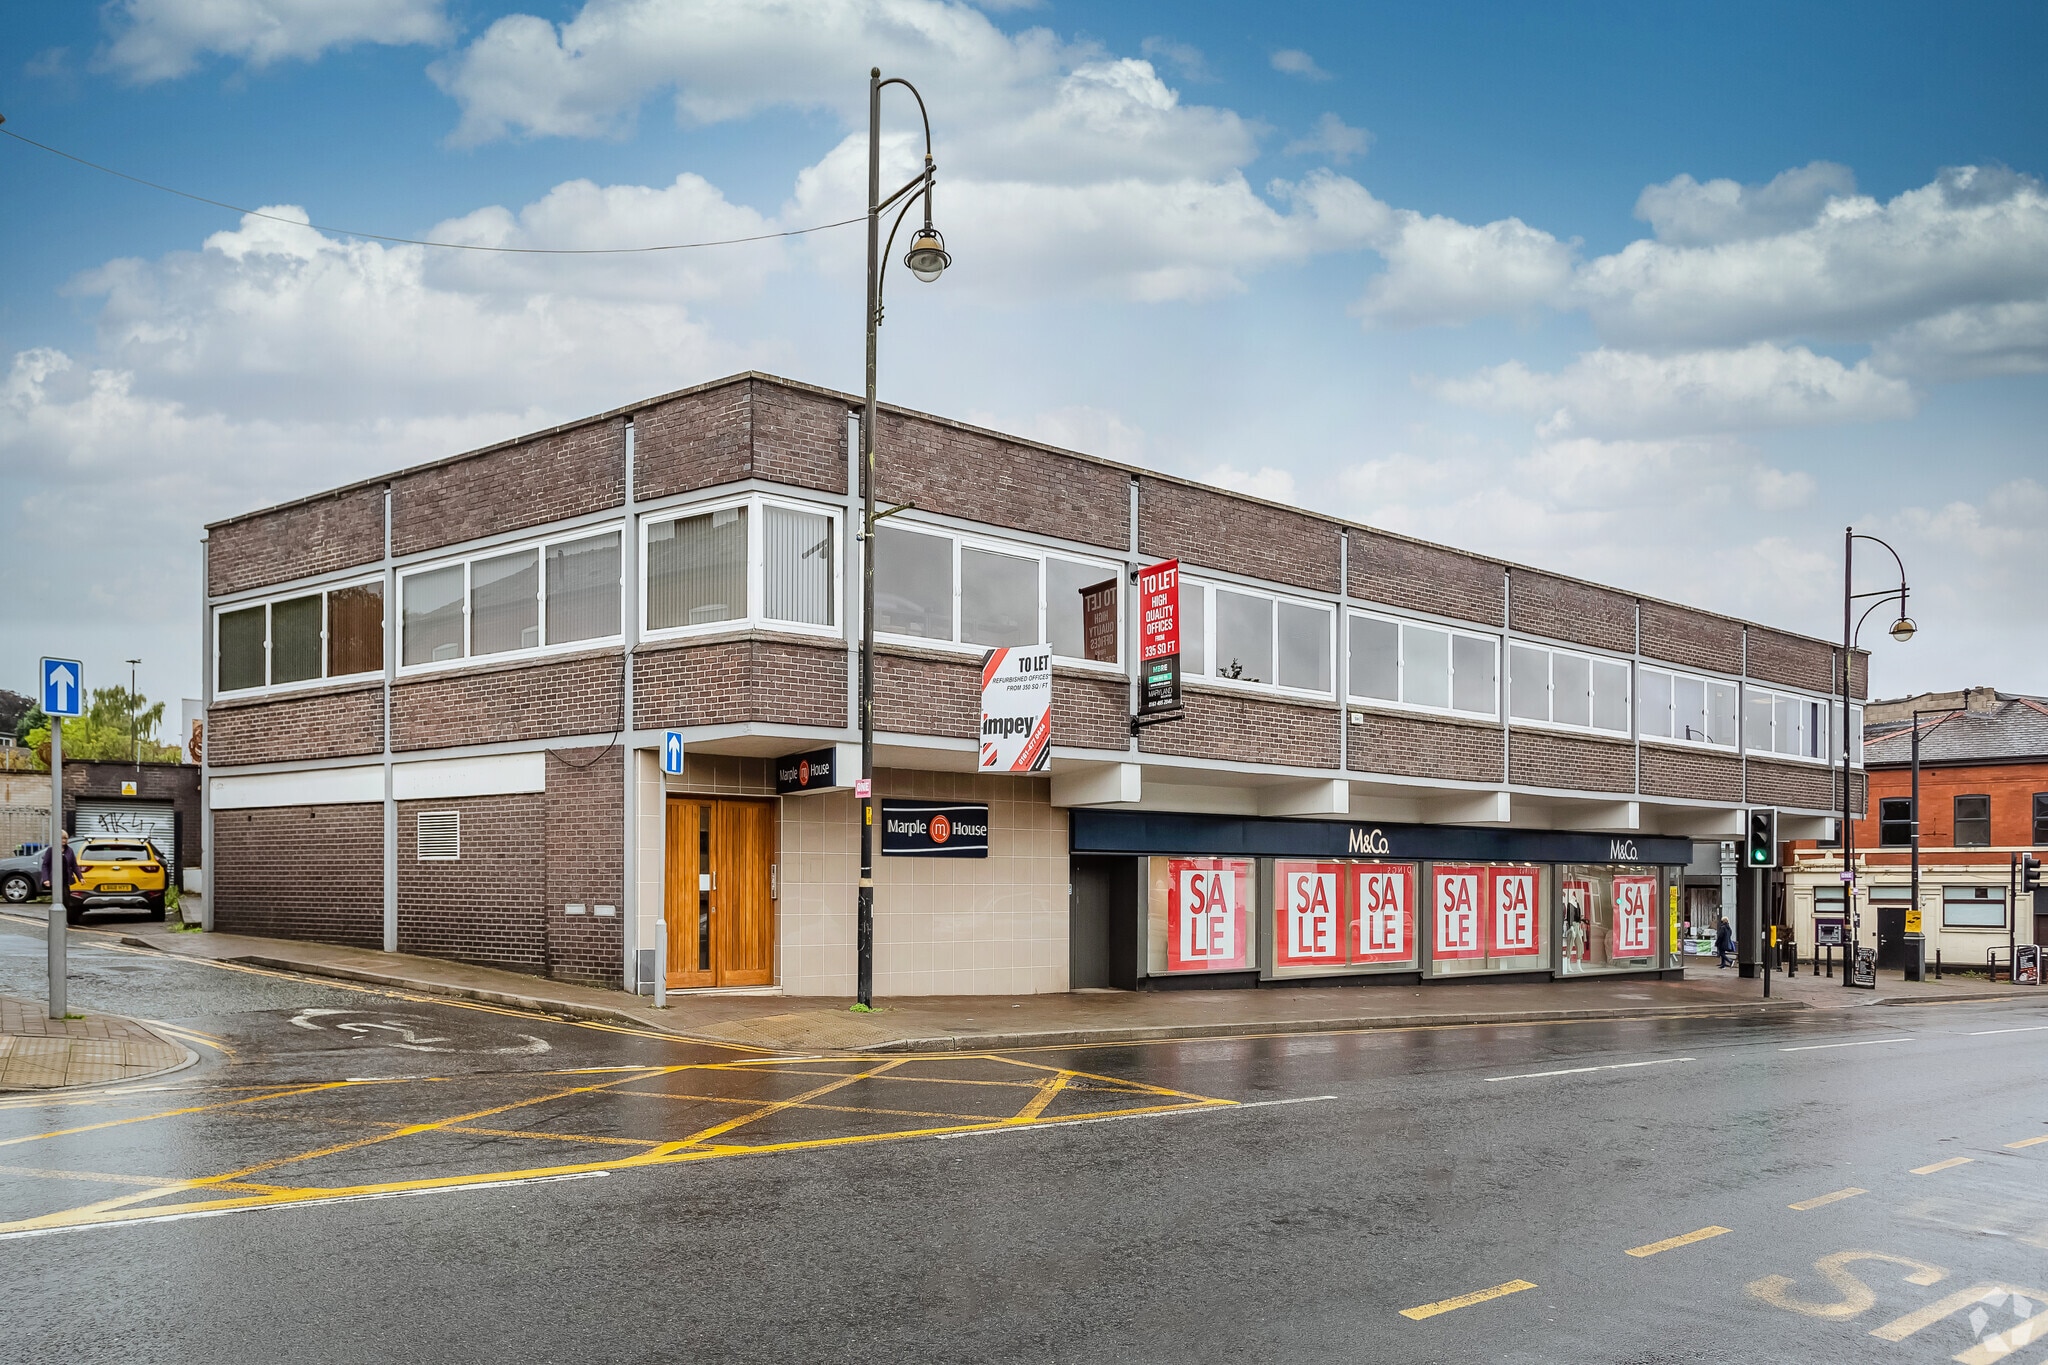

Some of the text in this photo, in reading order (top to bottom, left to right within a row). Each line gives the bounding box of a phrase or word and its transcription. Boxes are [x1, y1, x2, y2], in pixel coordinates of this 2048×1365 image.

[1142, 568, 1176, 595] TO LET
[1152, 593, 1167, 608] HIGH
[1146, 604, 1174, 622] QUALITY
[1146, 618, 1173, 635] OFFICES
[1145, 640, 1175, 657] 335 SQ FT
[1019, 655, 1049, 673] TO LET
[992, 676, 1027, 684] REFURBISHED
[983, 714, 1034, 739] impey
[780, 766, 798, 783] Marple
[810, 764, 829, 776] House
[888, 820, 926, 837] Marple
[952, 822, 987, 836] House
